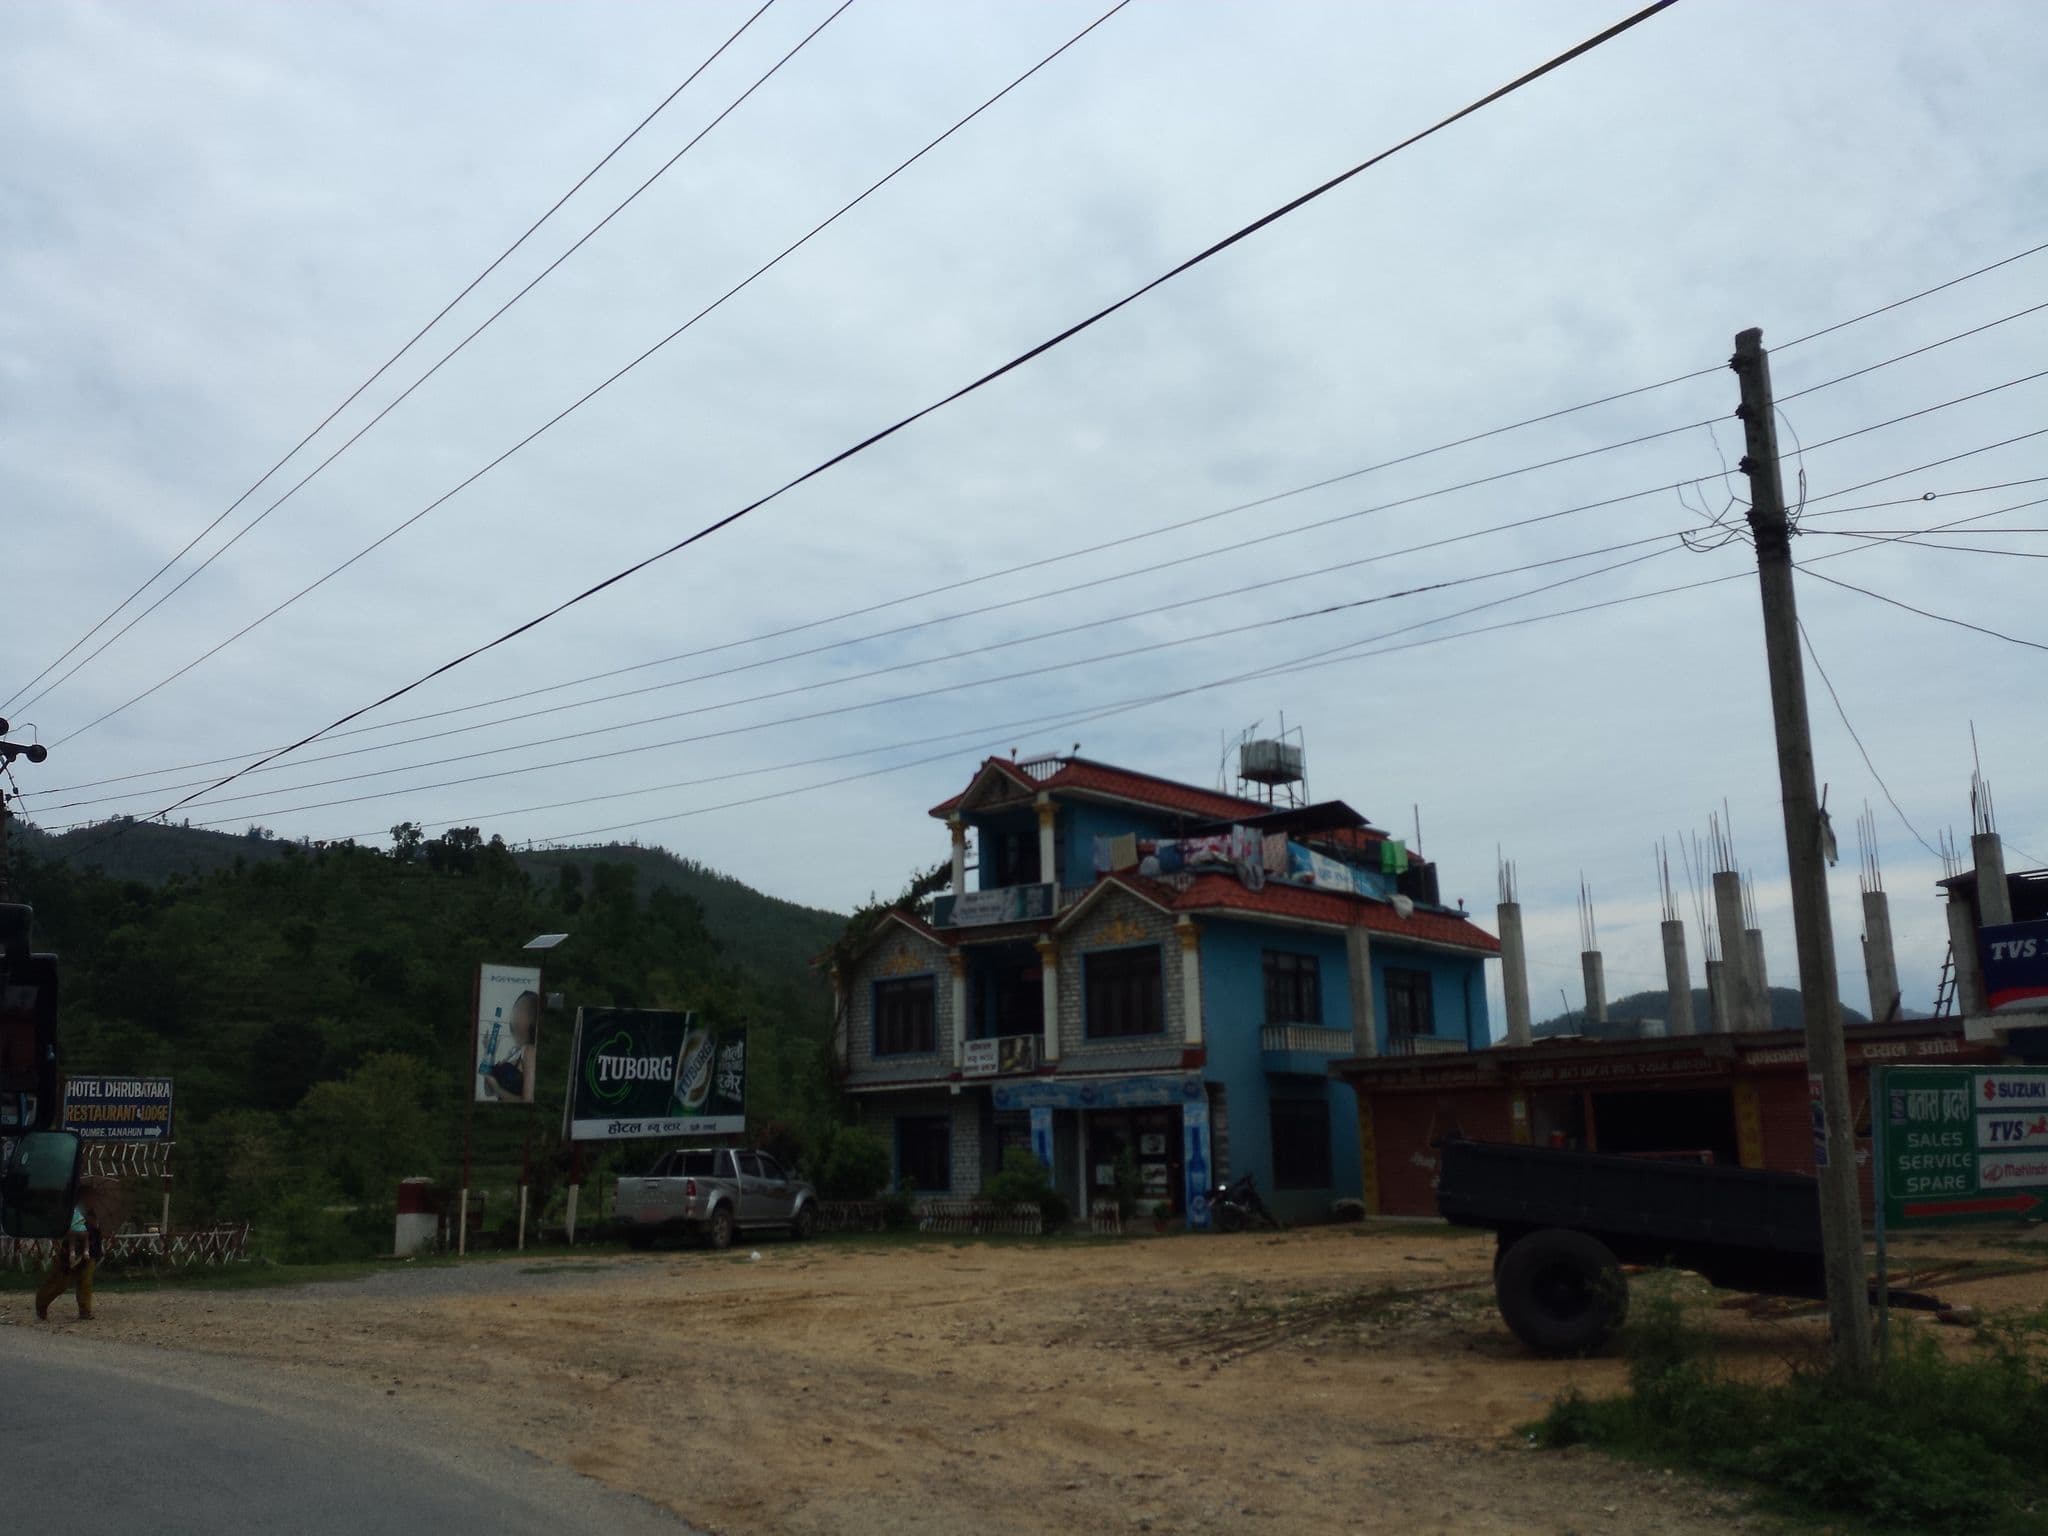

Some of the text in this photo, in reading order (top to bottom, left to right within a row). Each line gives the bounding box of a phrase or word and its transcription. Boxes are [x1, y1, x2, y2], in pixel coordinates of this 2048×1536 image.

[1991, 938, 2037, 961] TVS
[598, 1055, 672, 1081] TUBORG
[677, 1037, 714, 1096] TUBORG
[67, 1081, 170, 1098] HOTEL DHRUBATARA
[1998, 1082, 2046, 1098] SUZUKI
[66, 1104, 137, 1121] RESTAURANT
[141, 1104, 168, 1121] LODGE
[608, 1121, 641, 1135] होटल
[1989, 1121, 2023, 1141] TVS
[1907, 1132, 1962, 1148] SALES
[1898, 1153, 1973, 1170] SERVICE
[1906, 1175, 1966, 1192] SPARE
